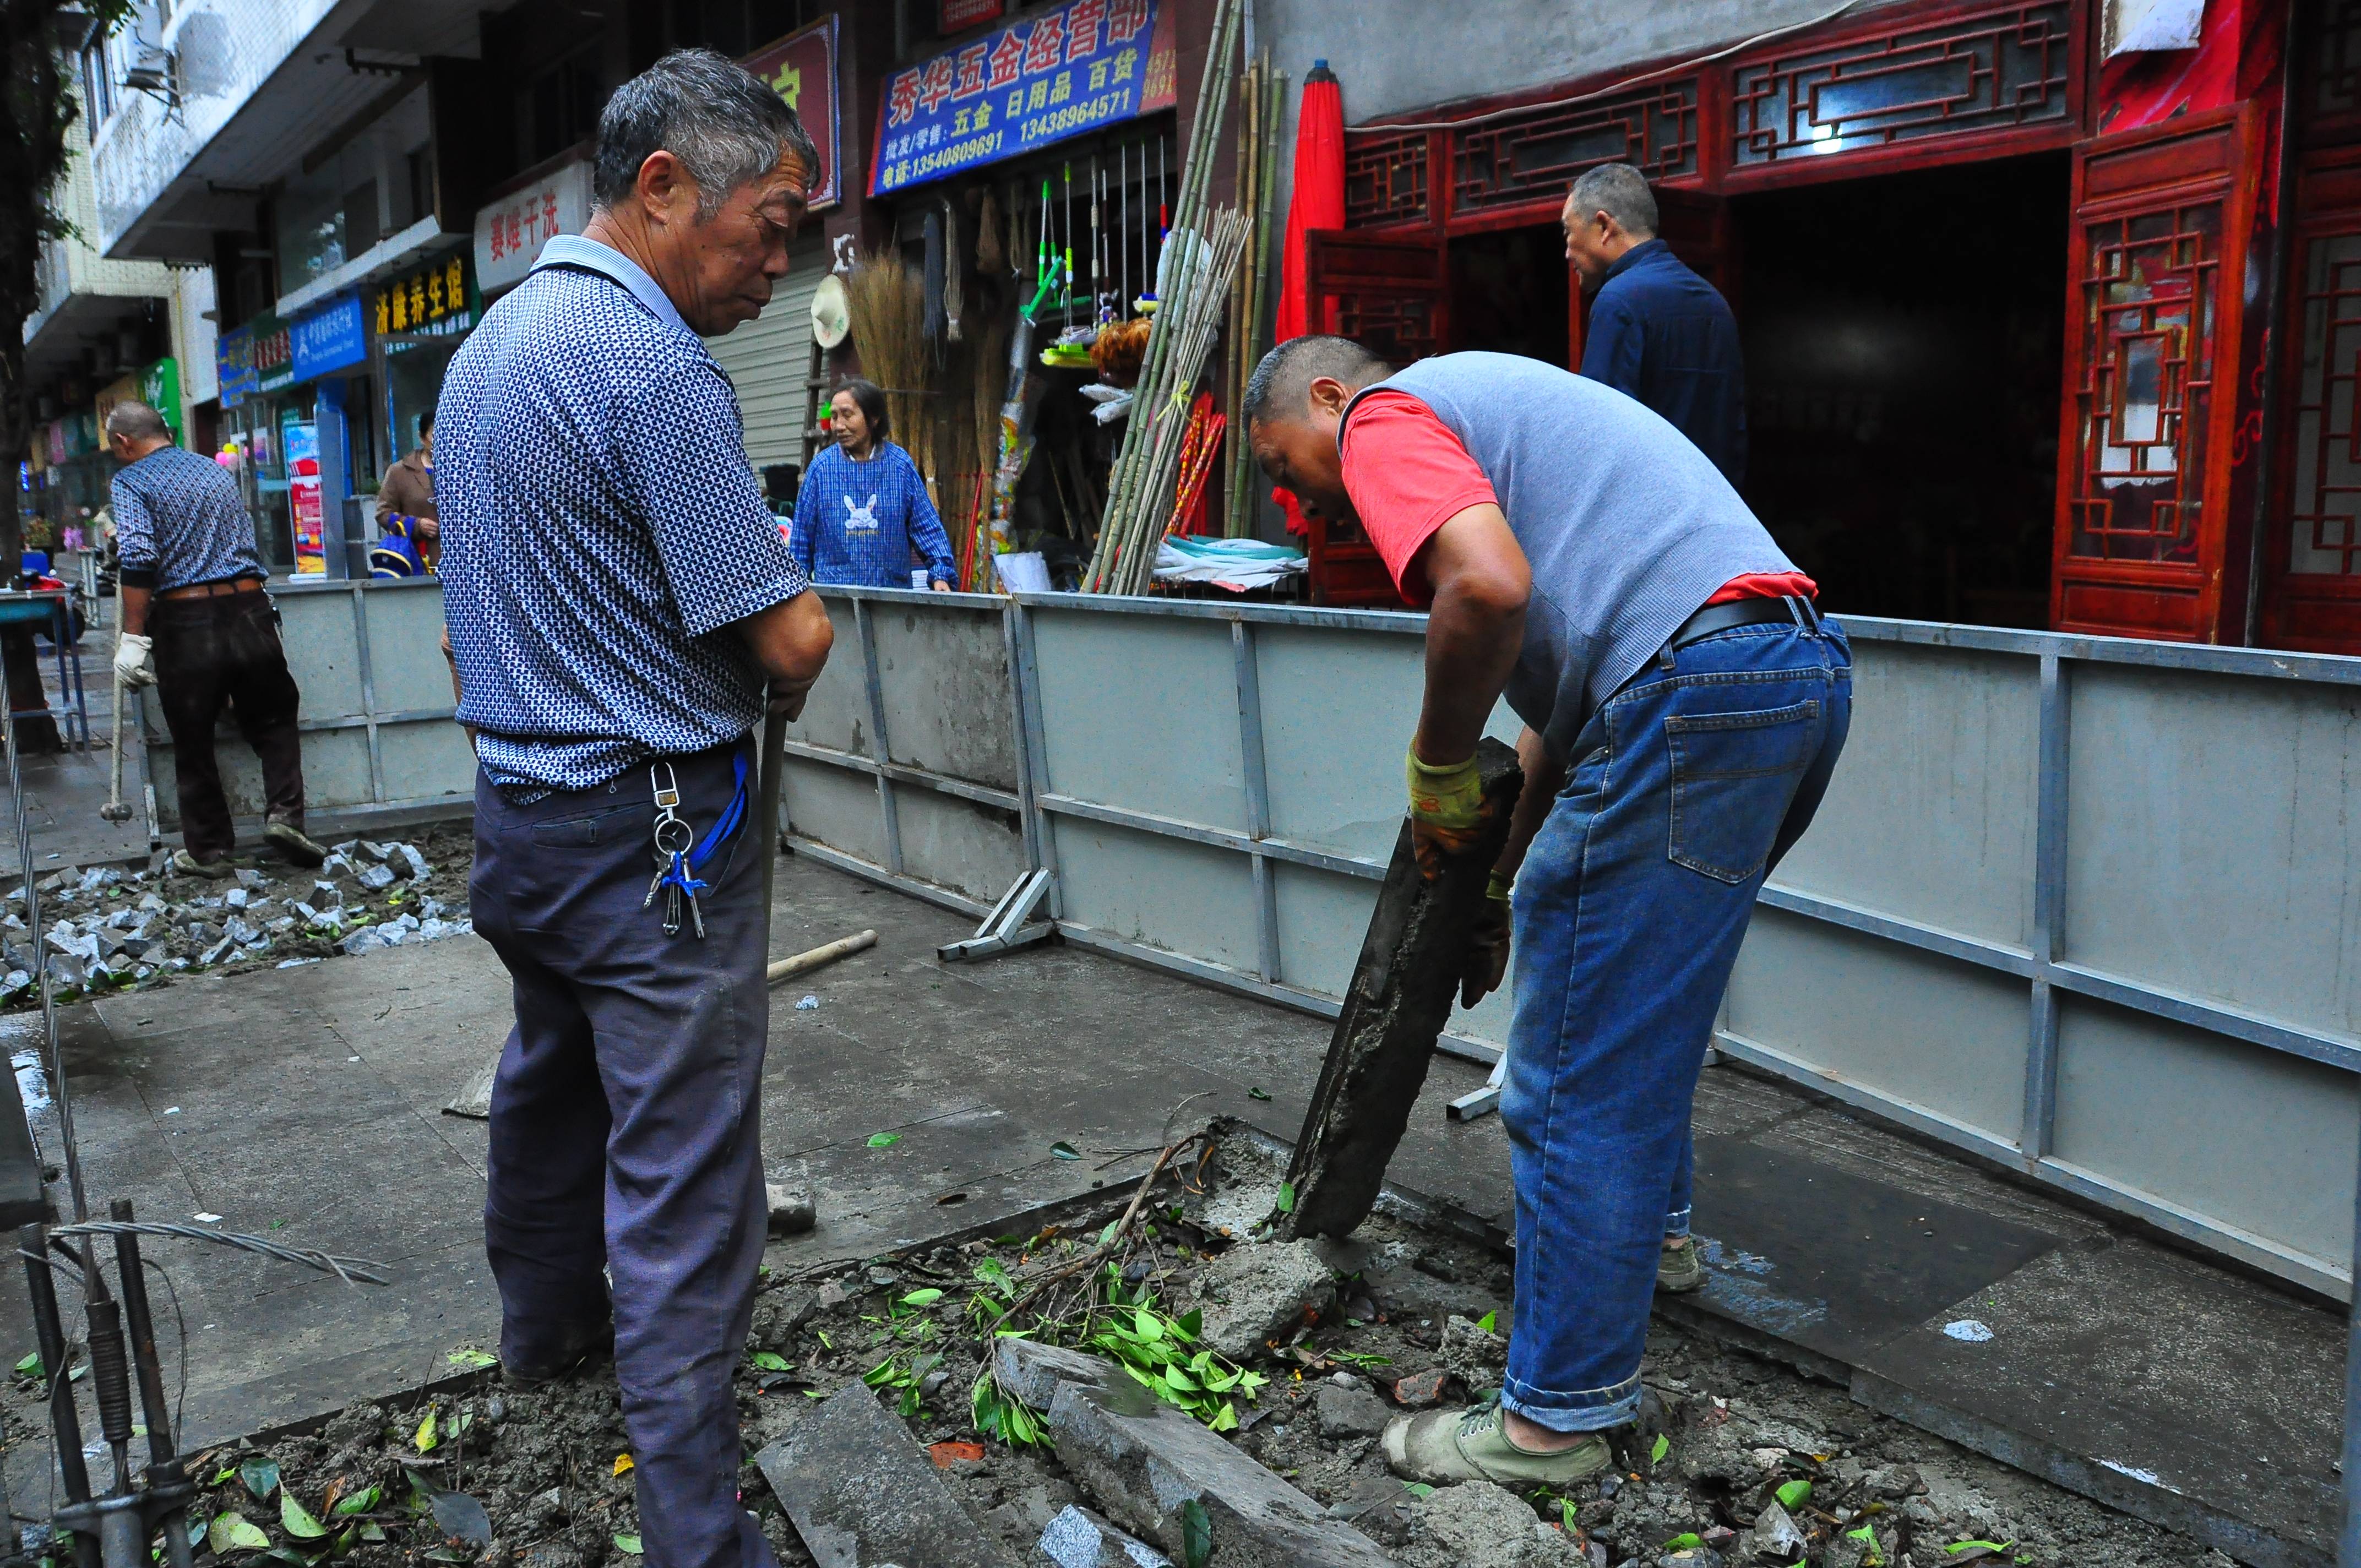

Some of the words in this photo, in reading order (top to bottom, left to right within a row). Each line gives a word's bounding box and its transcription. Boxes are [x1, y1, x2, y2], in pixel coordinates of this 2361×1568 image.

[888, 0, 1148, 127] 秀华五金经营部
[951, 100, 993, 138] 五金
[1007, 70, 1071, 119] 日用品
[1089, 47, 1138, 91] 百货
[1021, 88, 1130, 143] 13438964571
